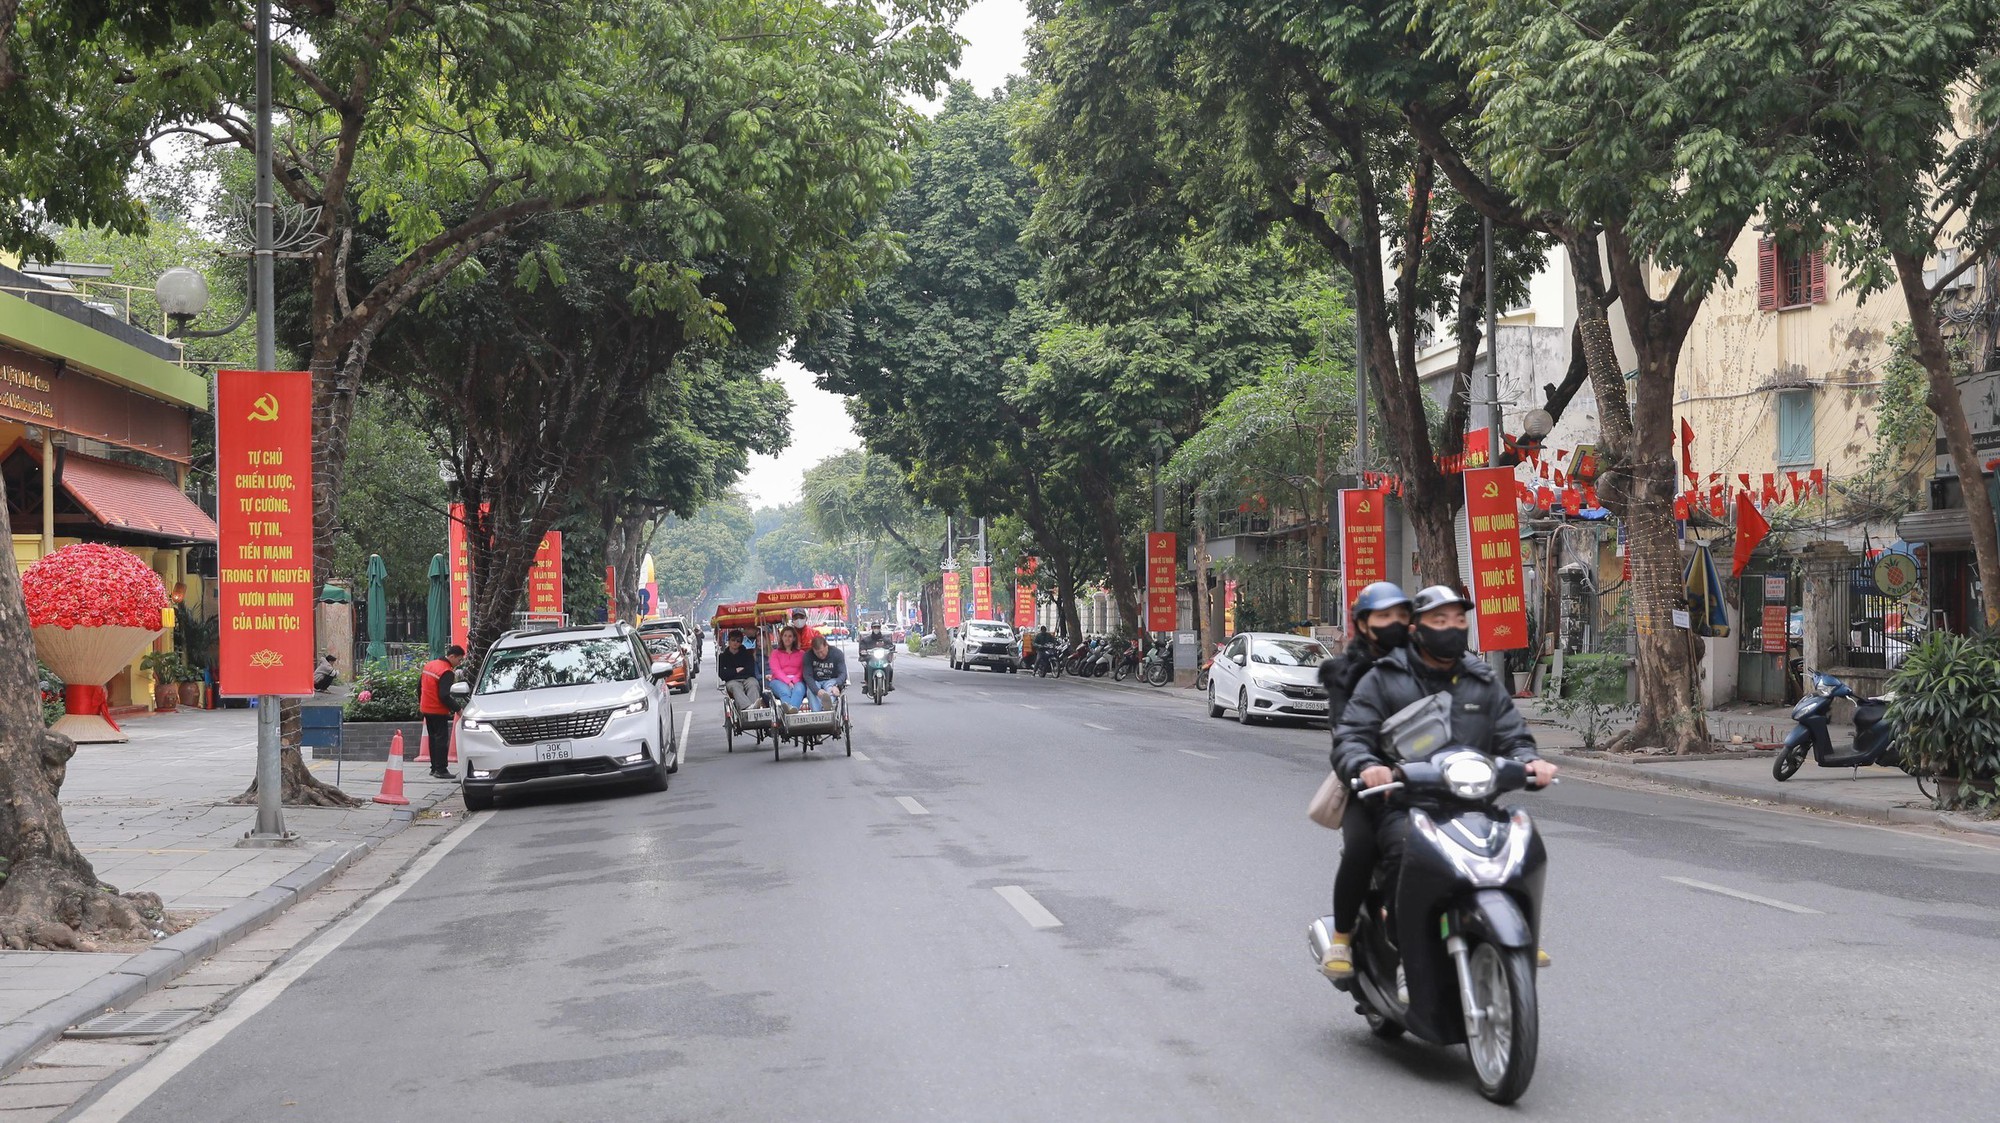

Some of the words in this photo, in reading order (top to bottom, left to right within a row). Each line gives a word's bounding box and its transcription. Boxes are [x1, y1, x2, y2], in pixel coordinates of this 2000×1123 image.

[248, 450, 261, 468] TỰ
[263, 447, 282, 465] CHỦ
[236, 470, 265, 488] CHIẾN
[268, 473, 295, 492] LƯỢC,
[240, 497, 253, 515] TỰ
[255, 496, 291, 514] CƯỜNG,
[249, 520, 262, 538] TỰ
[264, 522, 282, 538] TIN,
[1472, 515, 1490, 532] VINH
[1491, 513, 1515, 532] QUANG
[239, 542, 260, 559] TIẾN
[264, 546, 292, 562] MẠNH
[1481, 540, 1496, 560] MÃI
[1496, 538, 1512, 558] MÃI
[221, 569, 254, 583] TRONG
[256, 564, 268, 583] KỶ
[272, 566, 310, 583] NGUYÊN
[1481, 567, 1504, 589] THUỘC
[238, 592, 265, 606] VƯƠN
[268, 590, 294, 606] MÌNH
[1481, 595, 1501, 615] NHÂN
[1502, 594, 1520, 613] DÂN!
[233, 612, 252, 630] CỦA
[255, 613, 275, 630] DÂN
[278, 613, 300, 633] TỘC!
[542, 751, 568, 760] 187.68
[547, 744, 561, 752] 30K
